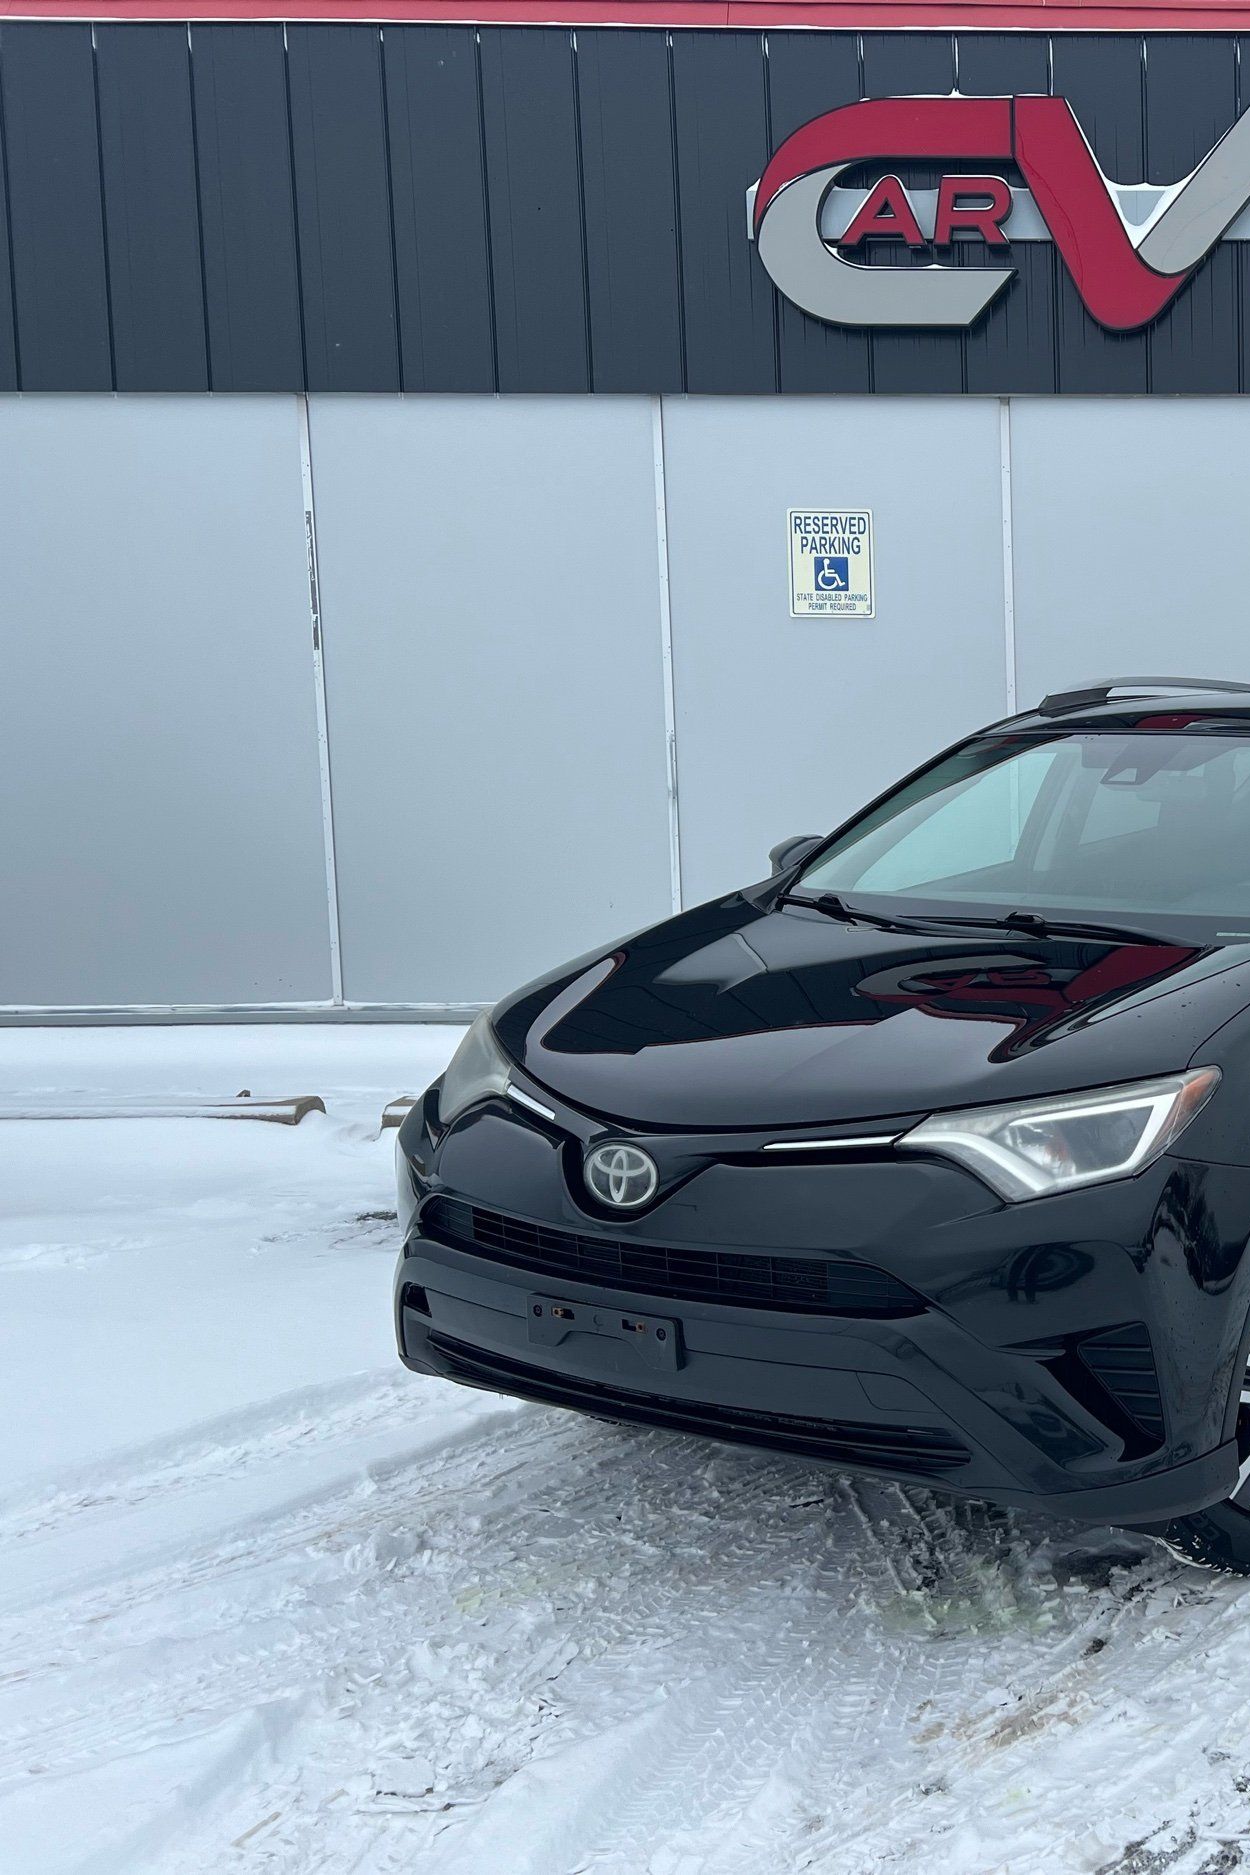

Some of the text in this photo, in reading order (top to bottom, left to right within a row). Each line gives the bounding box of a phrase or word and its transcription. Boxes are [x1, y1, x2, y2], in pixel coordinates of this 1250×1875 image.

[793, 515, 867, 535] RESERVED
[800, 536, 861, 554] PARKING
[796, 593, 868, 602] STATE DISABLED PARKING
[808, 602, 857, 611] PERMIT REQUIRED
